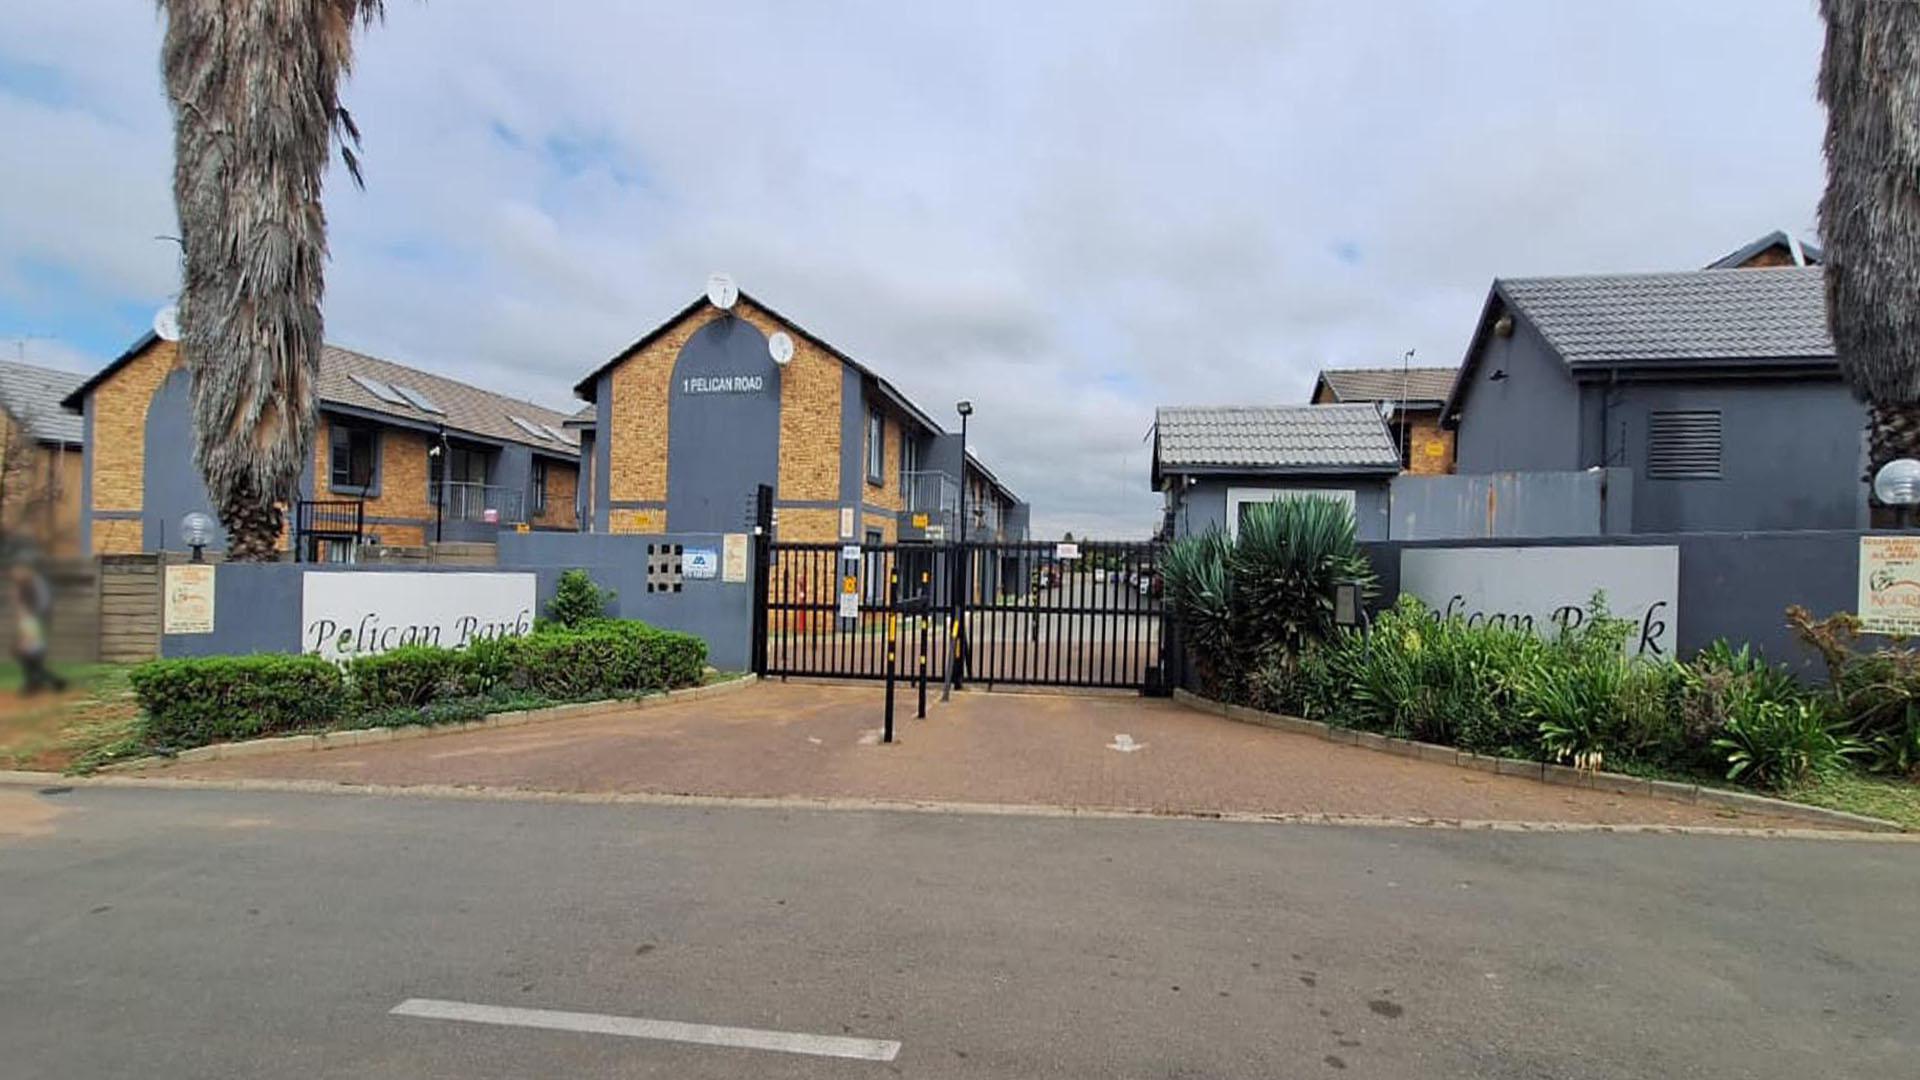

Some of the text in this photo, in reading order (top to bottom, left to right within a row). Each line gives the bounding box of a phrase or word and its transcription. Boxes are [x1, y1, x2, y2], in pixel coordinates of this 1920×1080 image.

[690, 376, 733, 392] PELICAN
[734, 375, 763, 391] ROAD
[308, 613, 441, 655] Pelican
[1551, 601, 1667, 655] Pk
